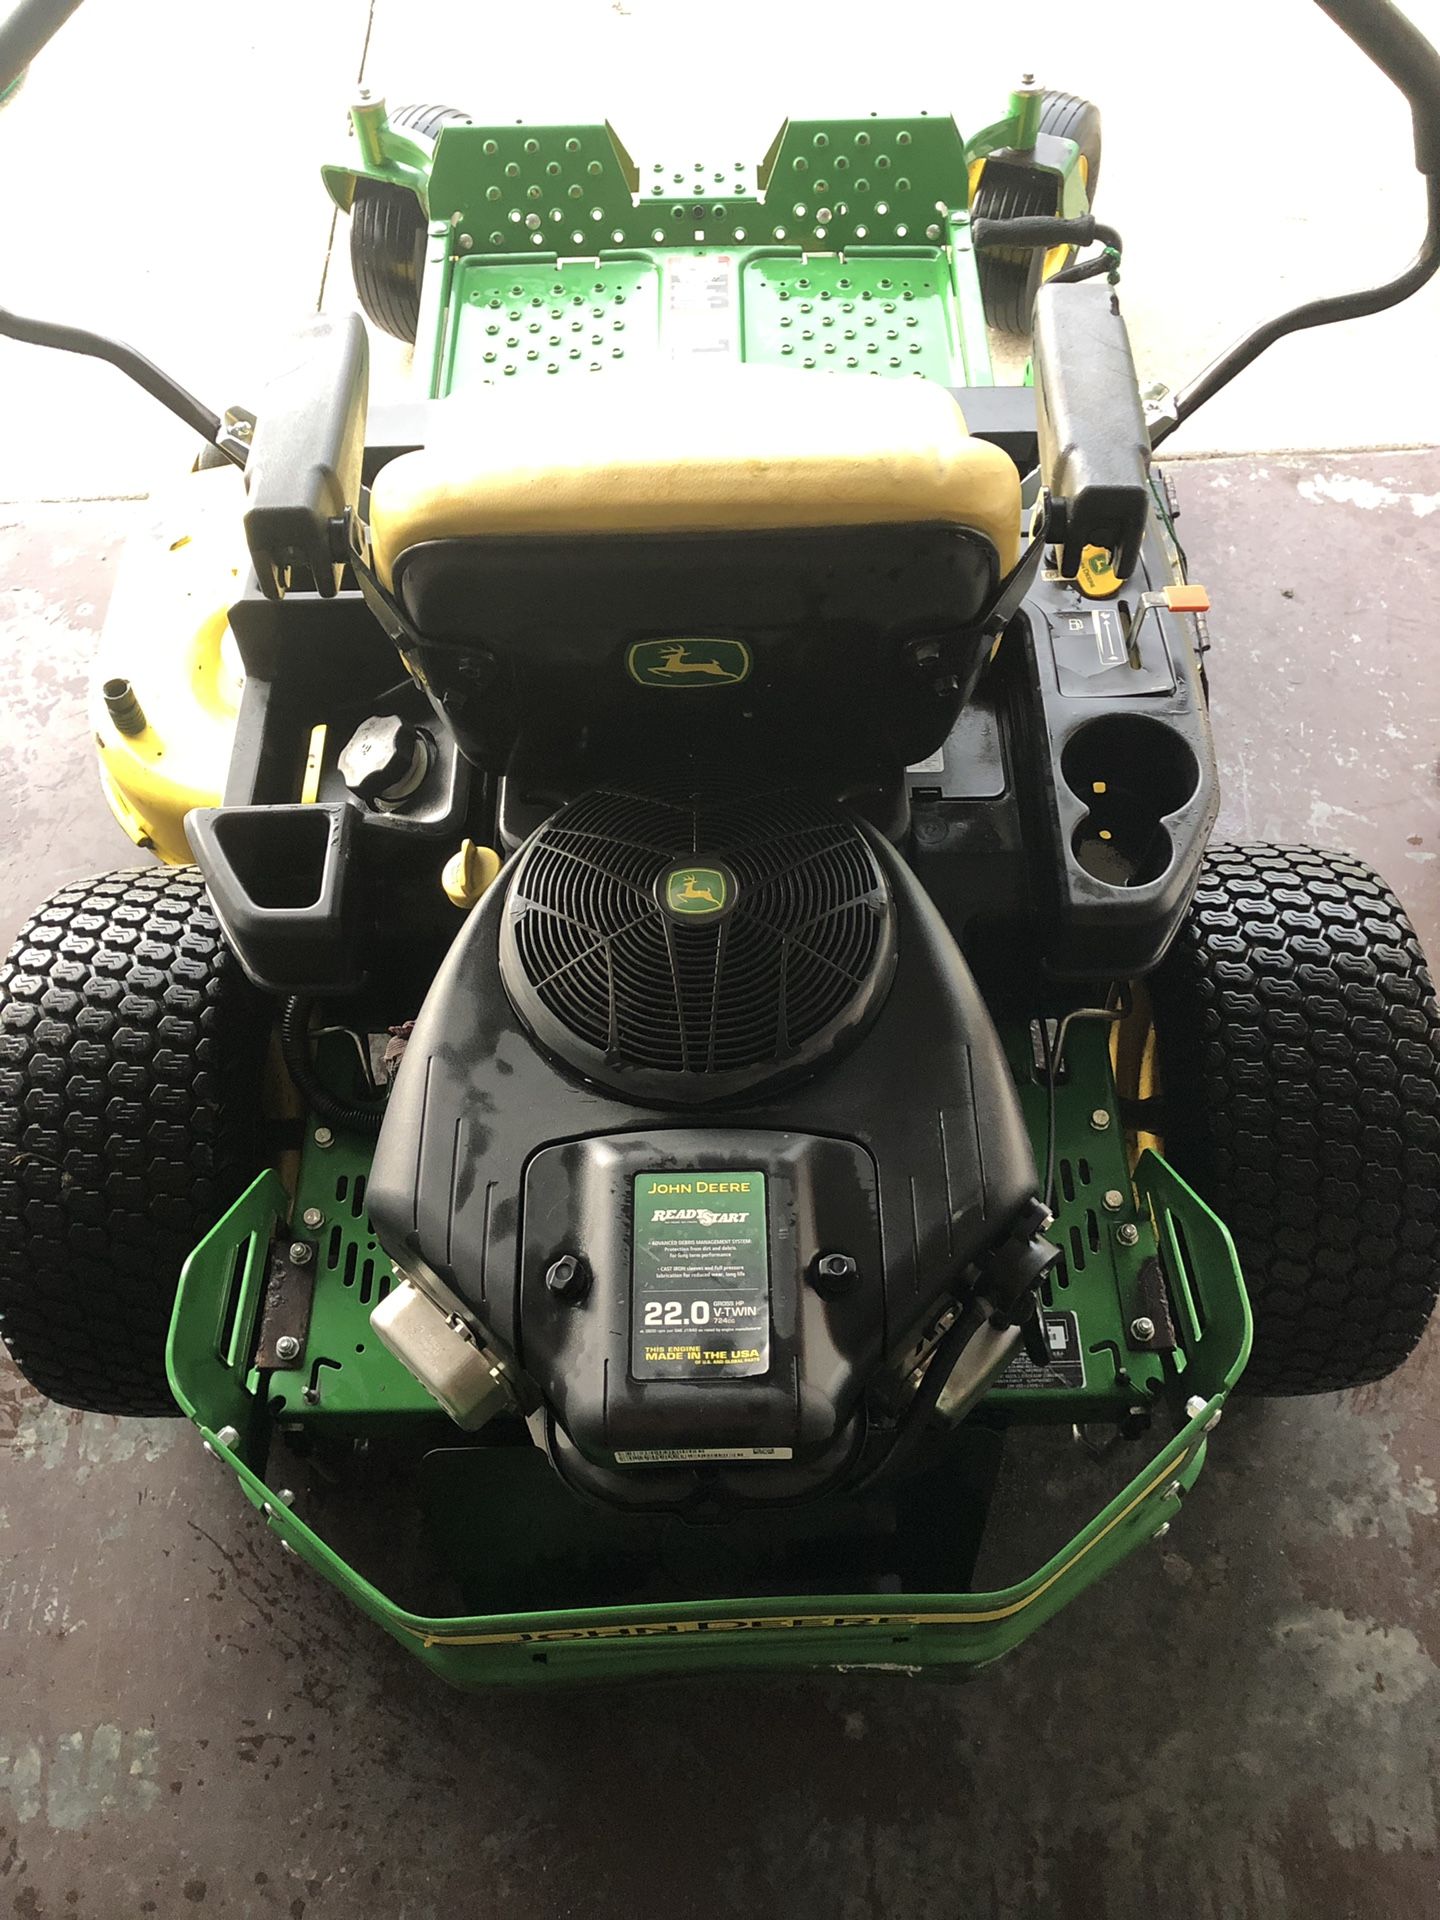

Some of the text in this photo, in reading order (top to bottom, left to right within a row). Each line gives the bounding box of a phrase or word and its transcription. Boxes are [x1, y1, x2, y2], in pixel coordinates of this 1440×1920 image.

[648, 1181, 751, 1194] JOHN DEERE
[644, 1301, 709, 1325] 22.0
[713, 1306, 757, 1317] V-TWIN
[645, 1353, 683, 1361] MADE
[703, 1351, 727, 1359] THE
[731, 1349, 759, 1359] USA
[518, 1615, 918, 1643] JOHN DEERE
